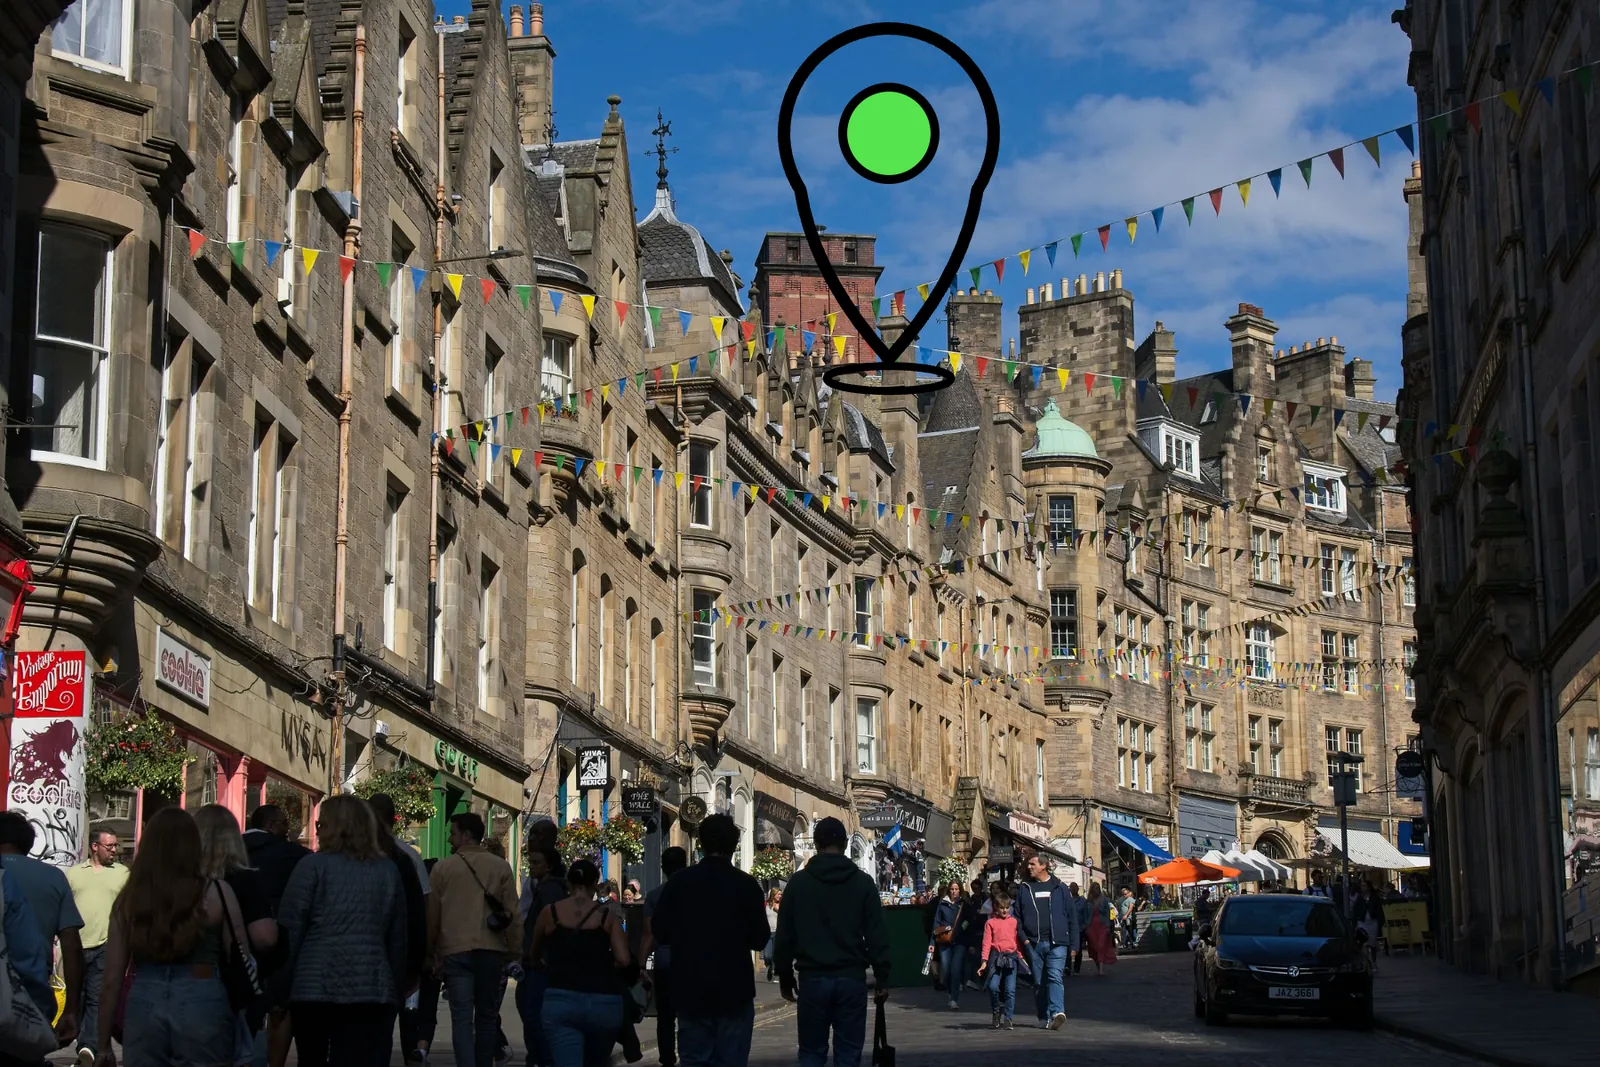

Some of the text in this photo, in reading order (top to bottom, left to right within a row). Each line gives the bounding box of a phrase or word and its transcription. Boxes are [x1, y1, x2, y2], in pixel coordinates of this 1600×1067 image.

[19, 651, 55, 680] Vintage
[161, 648, 204, 700] cookie
[17, 657, 83, 712] Emporium
[11, 779, 82, 810] cookie
[628, 801, 652, 809] WALL
[630, 791, 650, 800] THE
[1275, 988, 1314, 997] JAZ 3661
